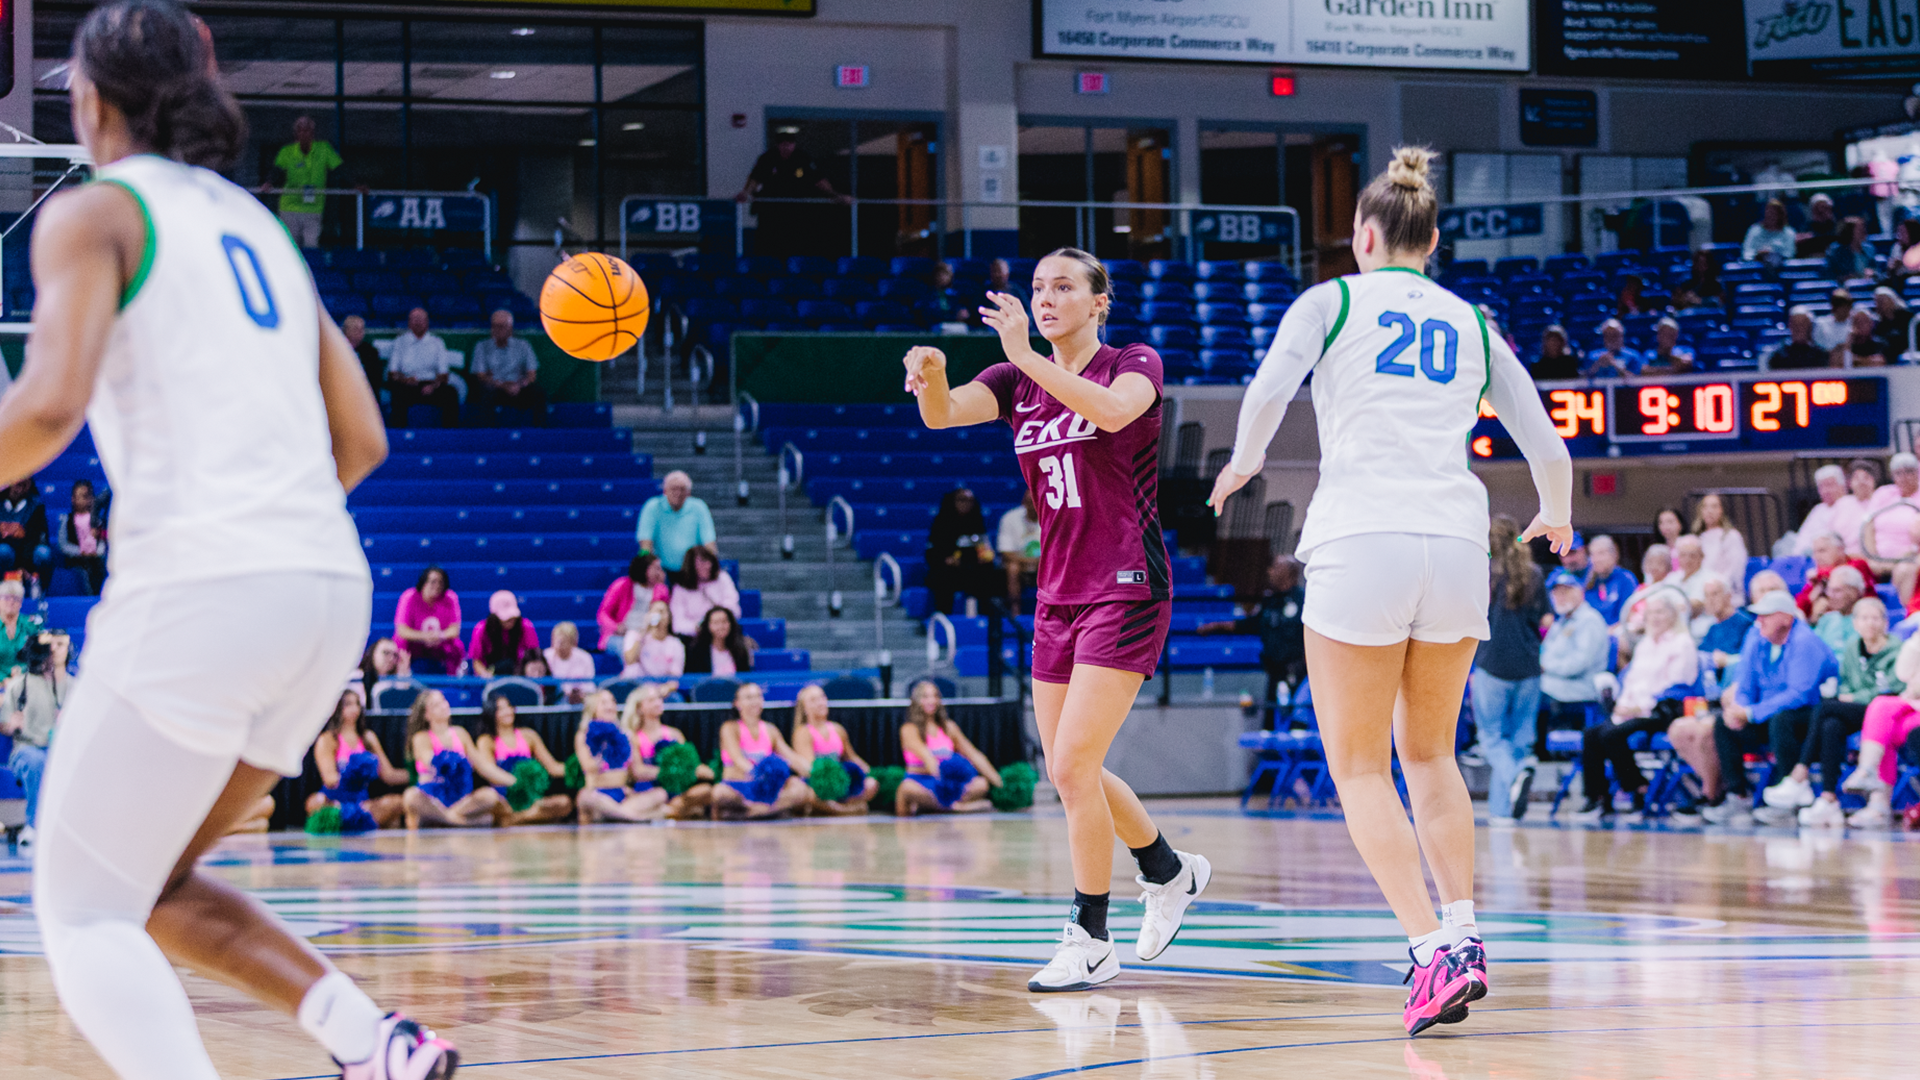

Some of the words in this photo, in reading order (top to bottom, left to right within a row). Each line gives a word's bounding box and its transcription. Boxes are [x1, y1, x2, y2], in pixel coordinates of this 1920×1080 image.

[1325, 0, 1433, 18] Garden
[1441, 0, 1494, 21] Inn
[1838, 0, 1920, 48] EAG
[1100, 31, 1166, 49] Corporate
[1170, 34, 1241, 50] Commerce
[1245, 37, 1275, 54] Way
[1346, 41, 1410, 57] Corporate
[1413, 43, 1483, 60] Commerce
[1486, 46, 1515, 63] Way
[400, 197, 447, 229] AA
[656, 201, 701, 232] BB
[1219, 213, 1261, 242] BB
[1465, 209, 1507, 238] CC
[221, 234, 280, 330] 0
[1375, 310, 1459, 385] 20
[1549, 389, 1605, 439] 34
[1638, 384, 1735, 436] 9:10
[1750, 380, 1809, 432] 27
[1014, 412, 1099, 448] EKU
[1038, 452, 1082, 510] 31
[1135, 573, 1142, 581] L
